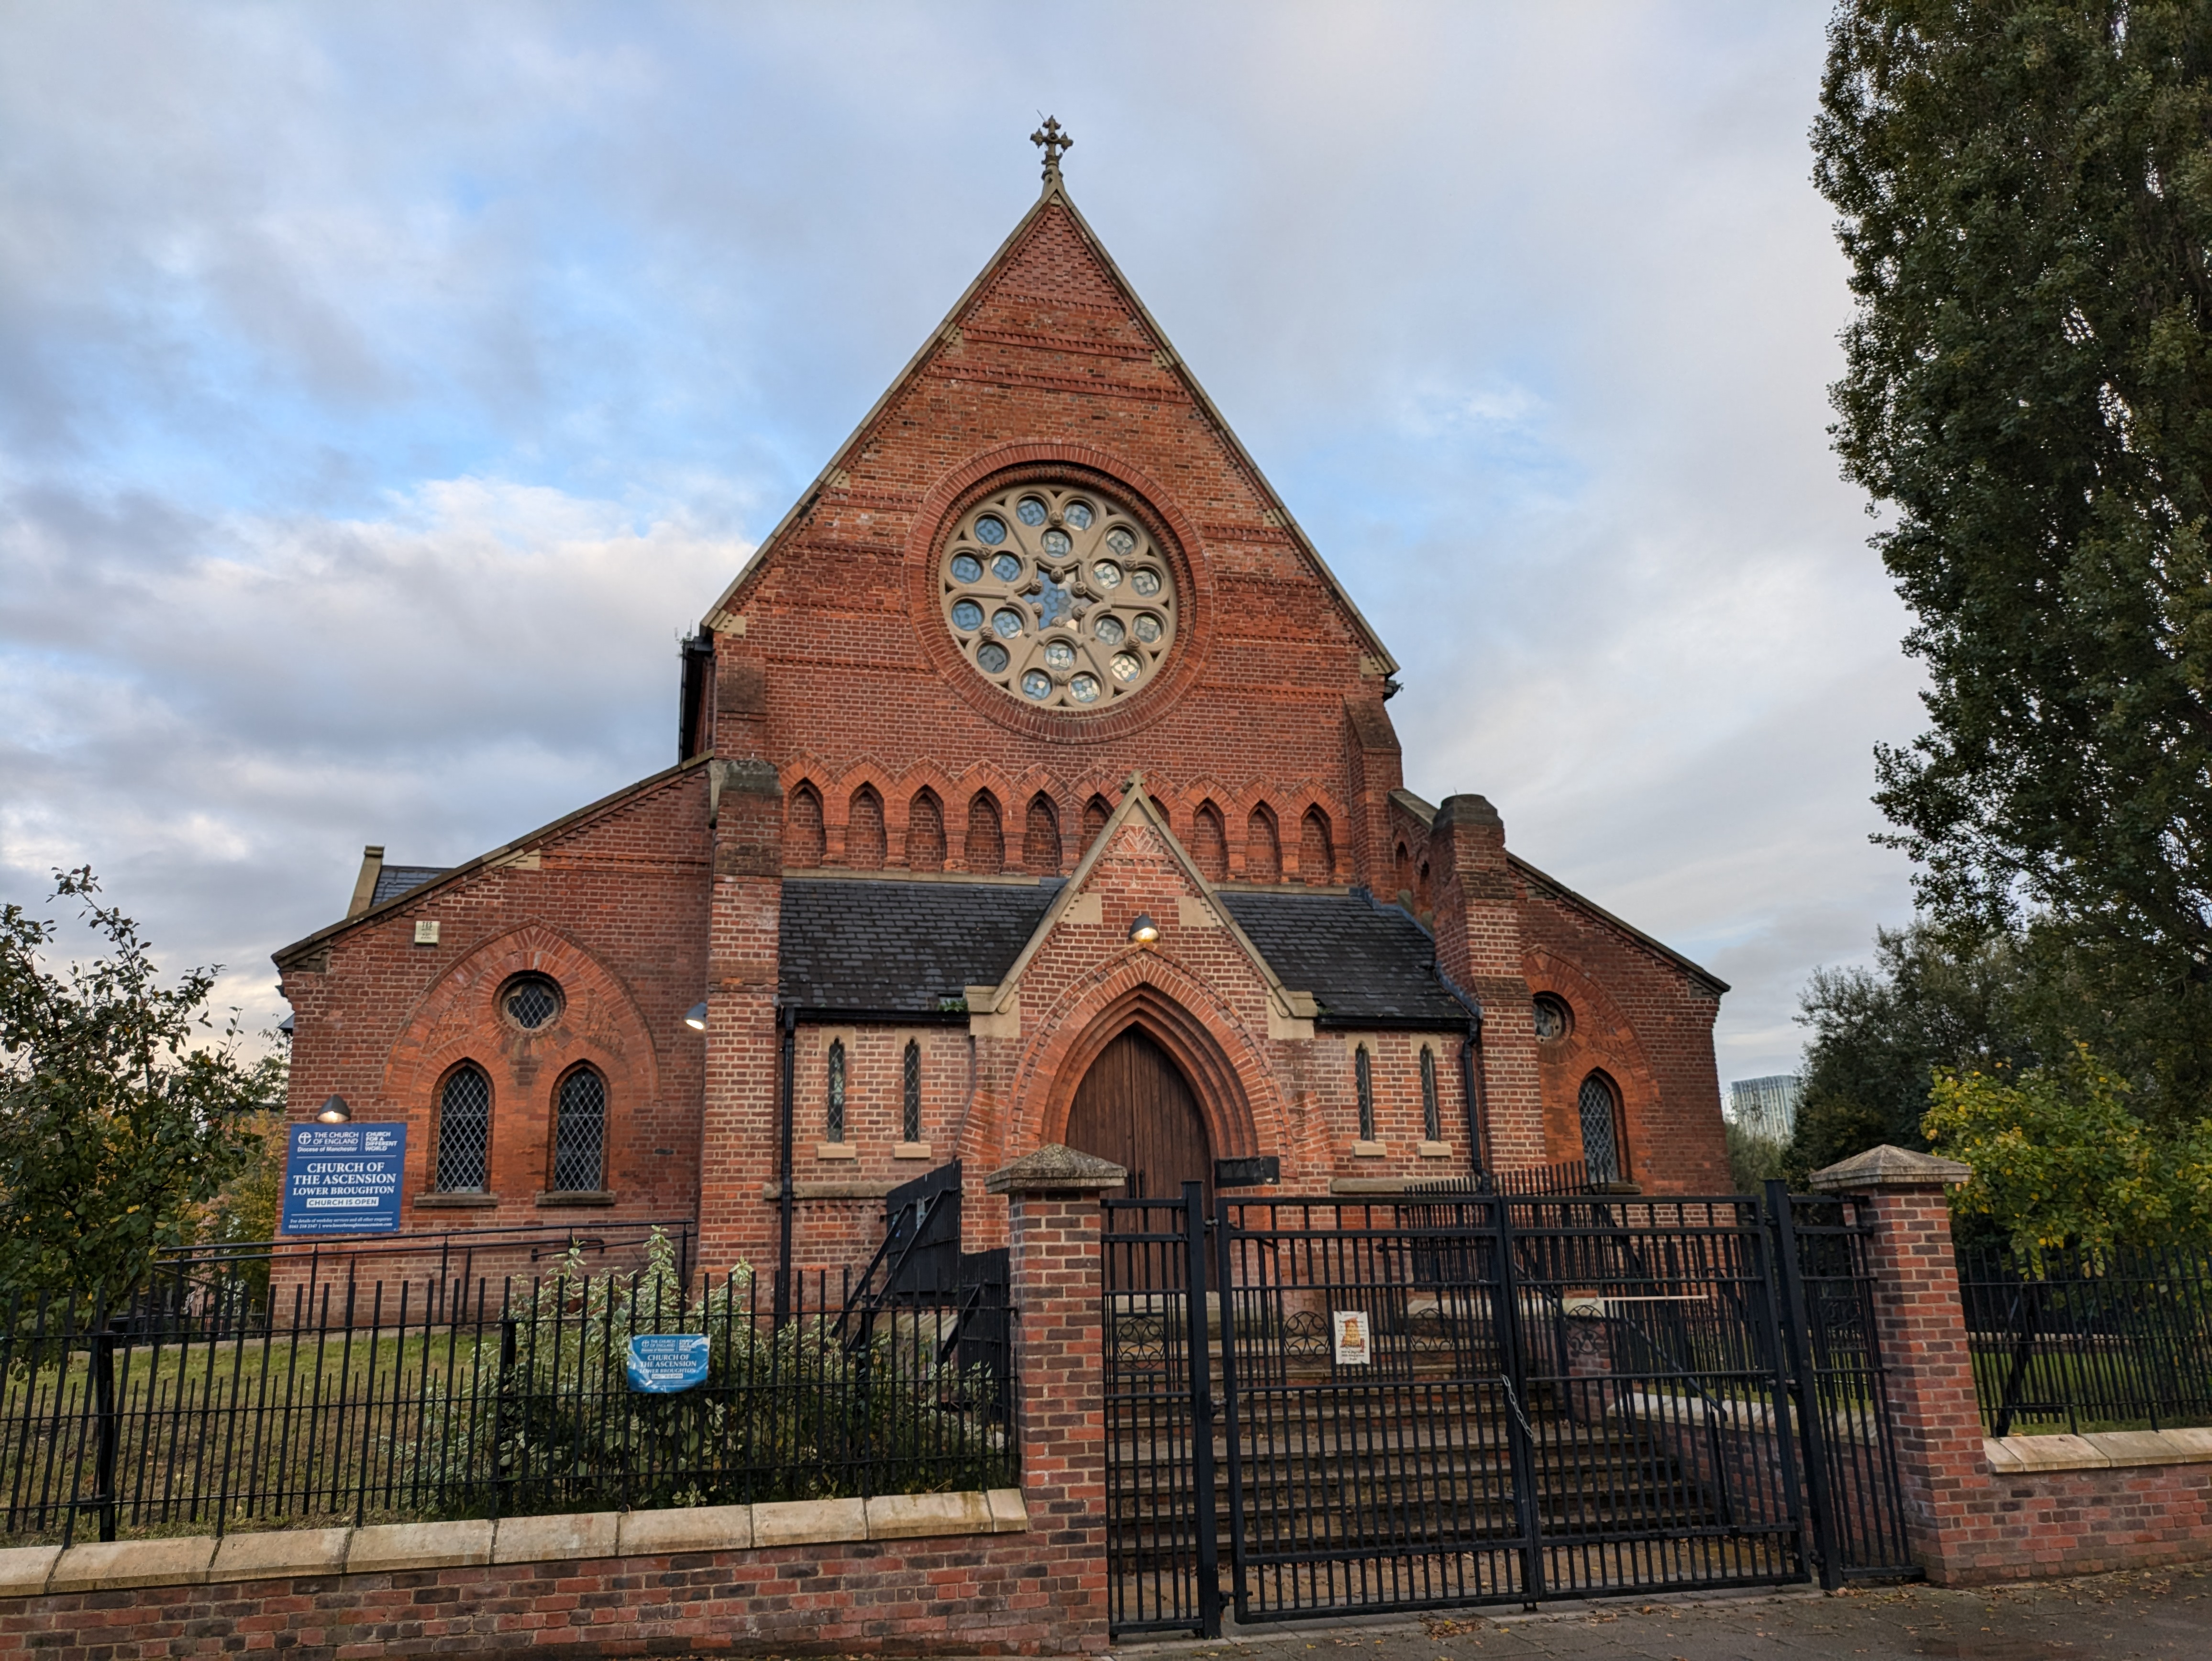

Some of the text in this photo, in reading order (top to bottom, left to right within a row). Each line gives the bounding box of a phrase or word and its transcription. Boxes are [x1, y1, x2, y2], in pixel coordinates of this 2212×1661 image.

[307, 1162, 385, 1173] CHURCH OF
[293, 1173, 397, 1185] THE ASCENSION
[293, 1185, 395, 1196] LOWER BROUGHTON
